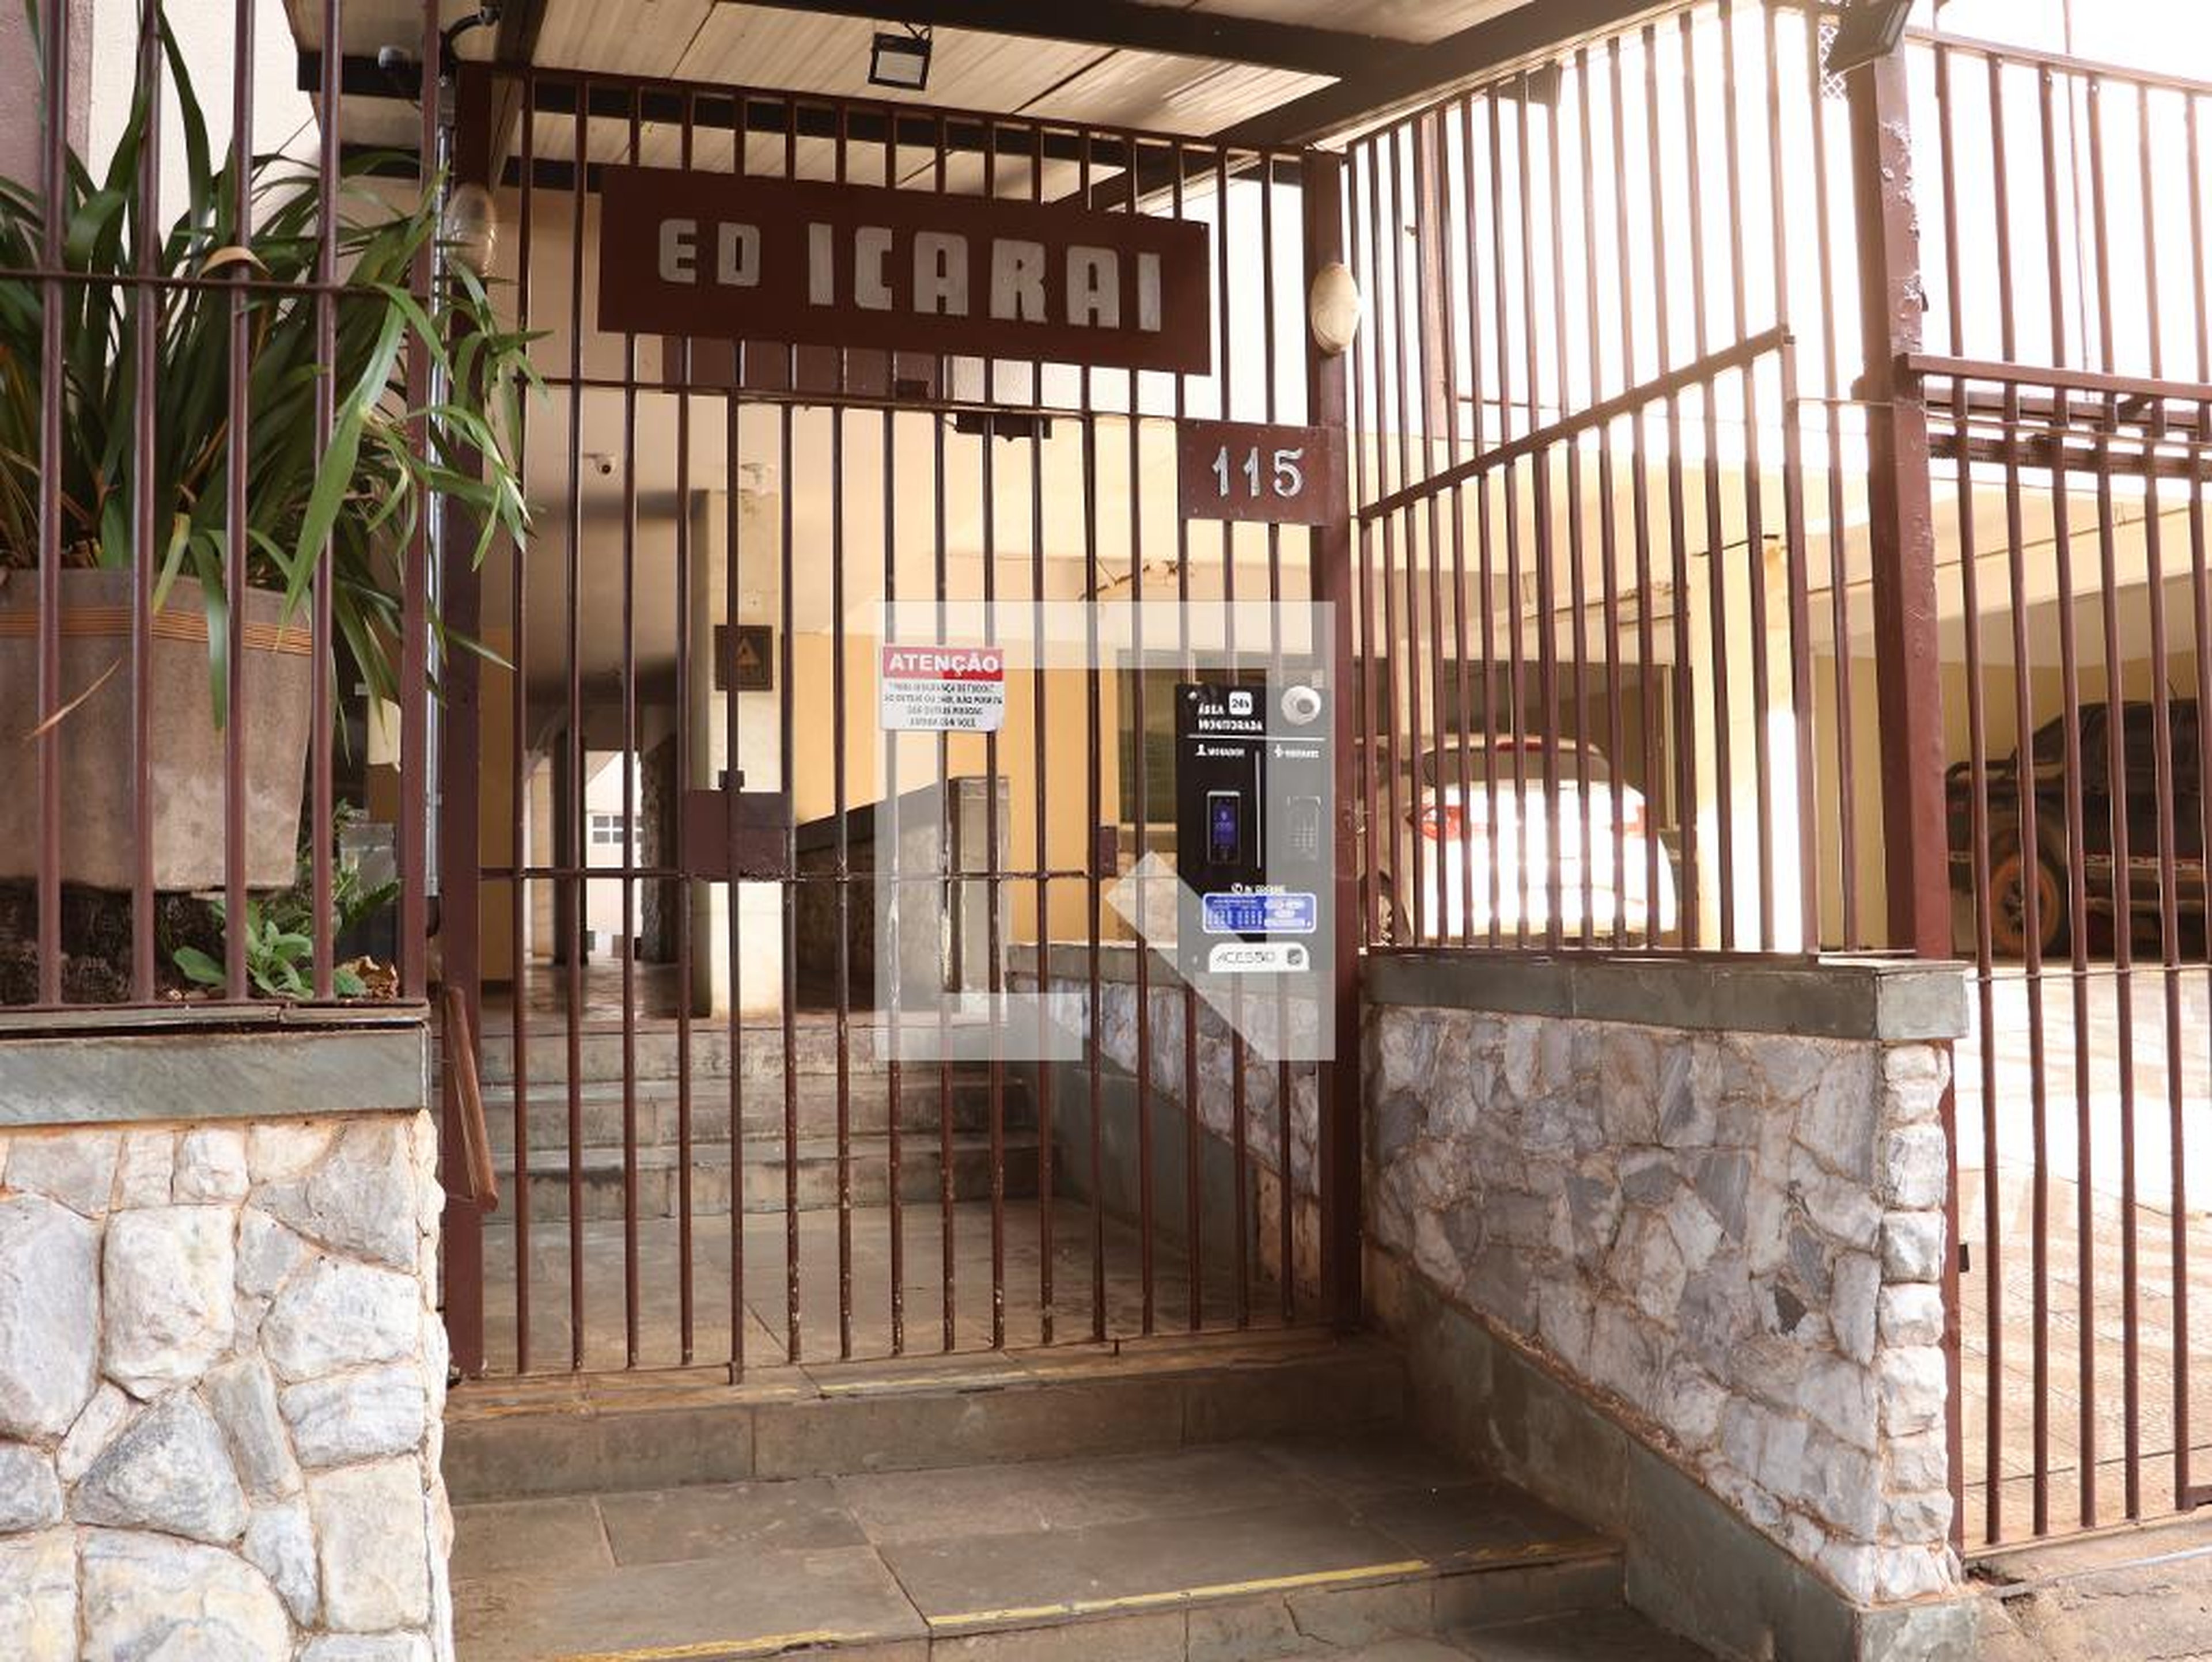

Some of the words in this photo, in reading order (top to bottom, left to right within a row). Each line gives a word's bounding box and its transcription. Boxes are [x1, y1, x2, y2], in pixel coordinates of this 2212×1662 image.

[658, 218, 760, 286] ED
[809, 223, 1160, 332] ICARAI
[1212, 446, 1304, 497] 115
[889, 652, 999, 677] ATENÇÃO
